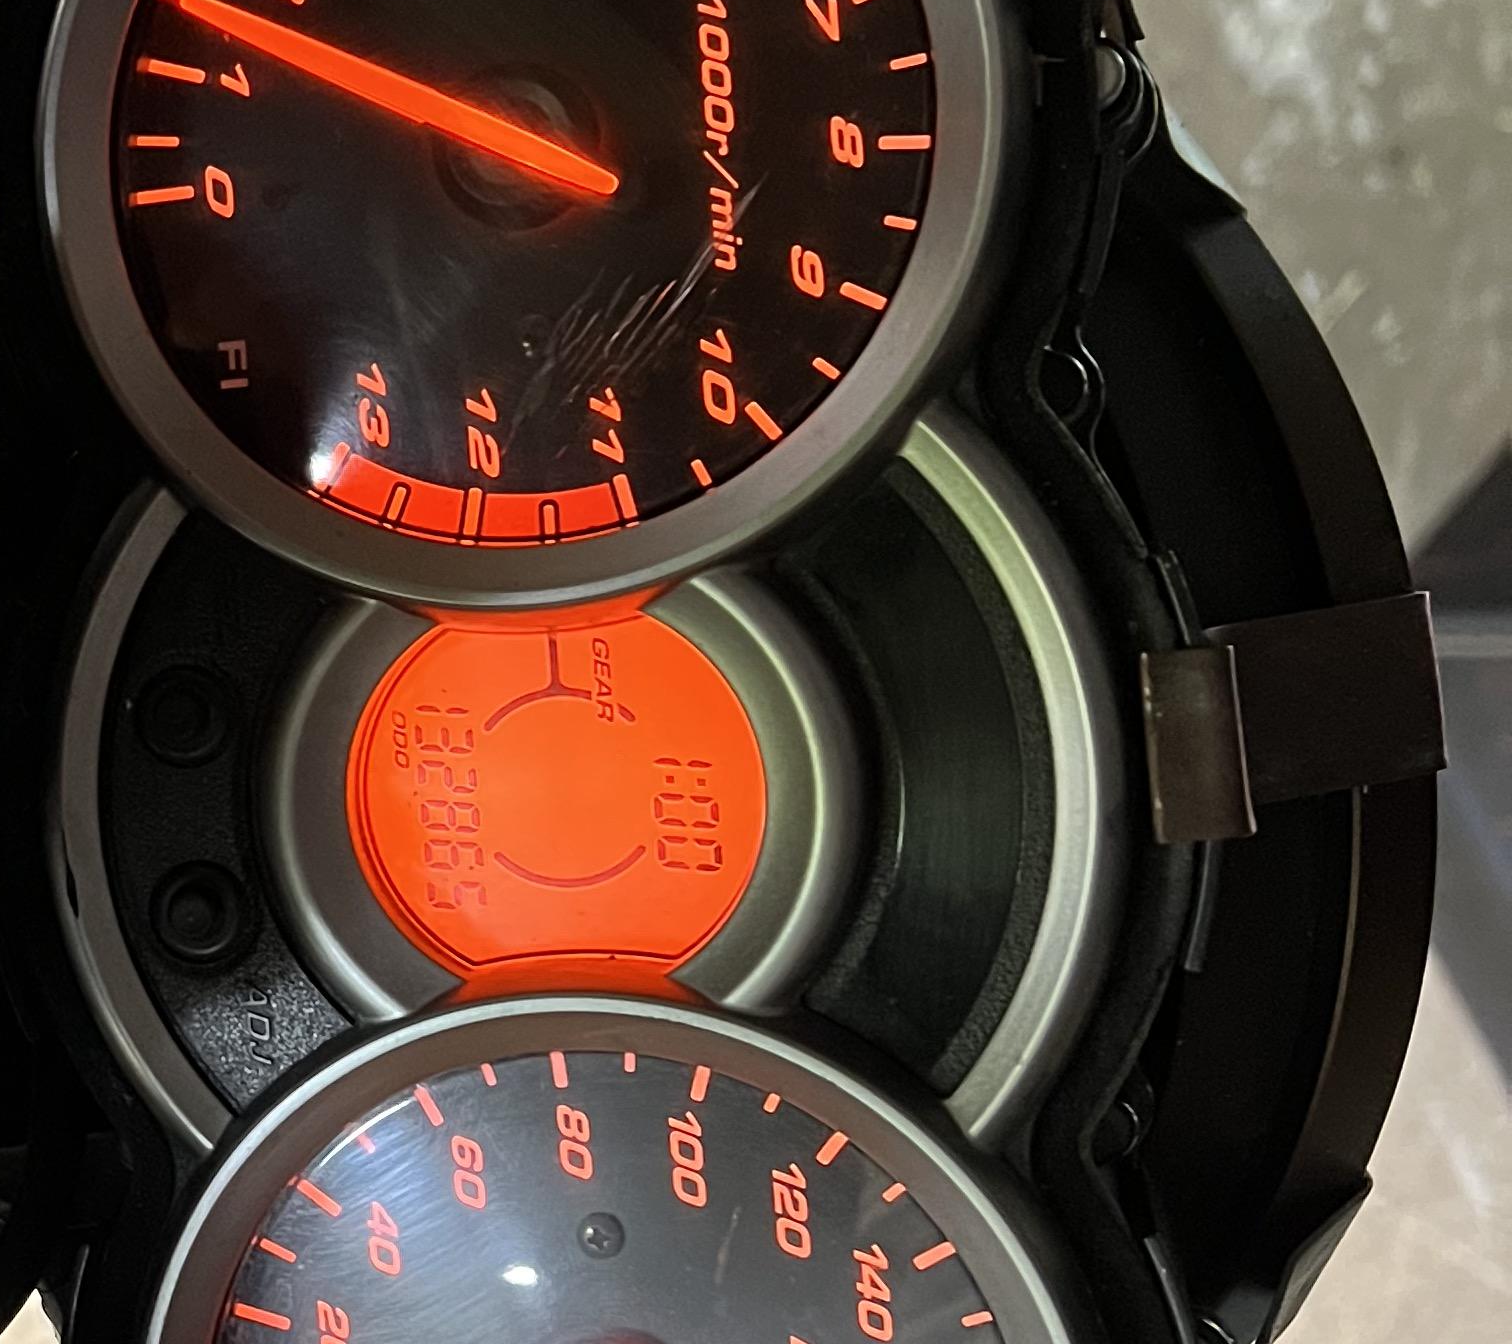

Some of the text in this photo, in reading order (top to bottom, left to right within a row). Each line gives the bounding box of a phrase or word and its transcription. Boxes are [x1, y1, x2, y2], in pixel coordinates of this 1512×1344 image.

[219, 62, 252, 98] 1
[829, 115, 865, 169] 8
[204, 165, 235, 218] 0
[790, 244, 825, 298] 9
[216, 339, 249, 390] FI
[699, 328, 737, 425] 10
[356, 362, 390, 448] 13
[465, 388, 501, 478] 12
[589, 387, 625, 464] 11
[592, 637, 614, 723] GEAR
[391, 710, 409, 769] ODO
[414, 704, 487, 908] 132865
[654, 757, 724, 872] 1:00
[450, 1135, 487, 1211] 60
[556, 1104, 594, 1180] 80
[667, 1111, 707, 1207] 100
[368, 1201, 401, 1276] 40
[771, 1163, 812, 1259] 120
[853, 1244, 894, 1342] 140
